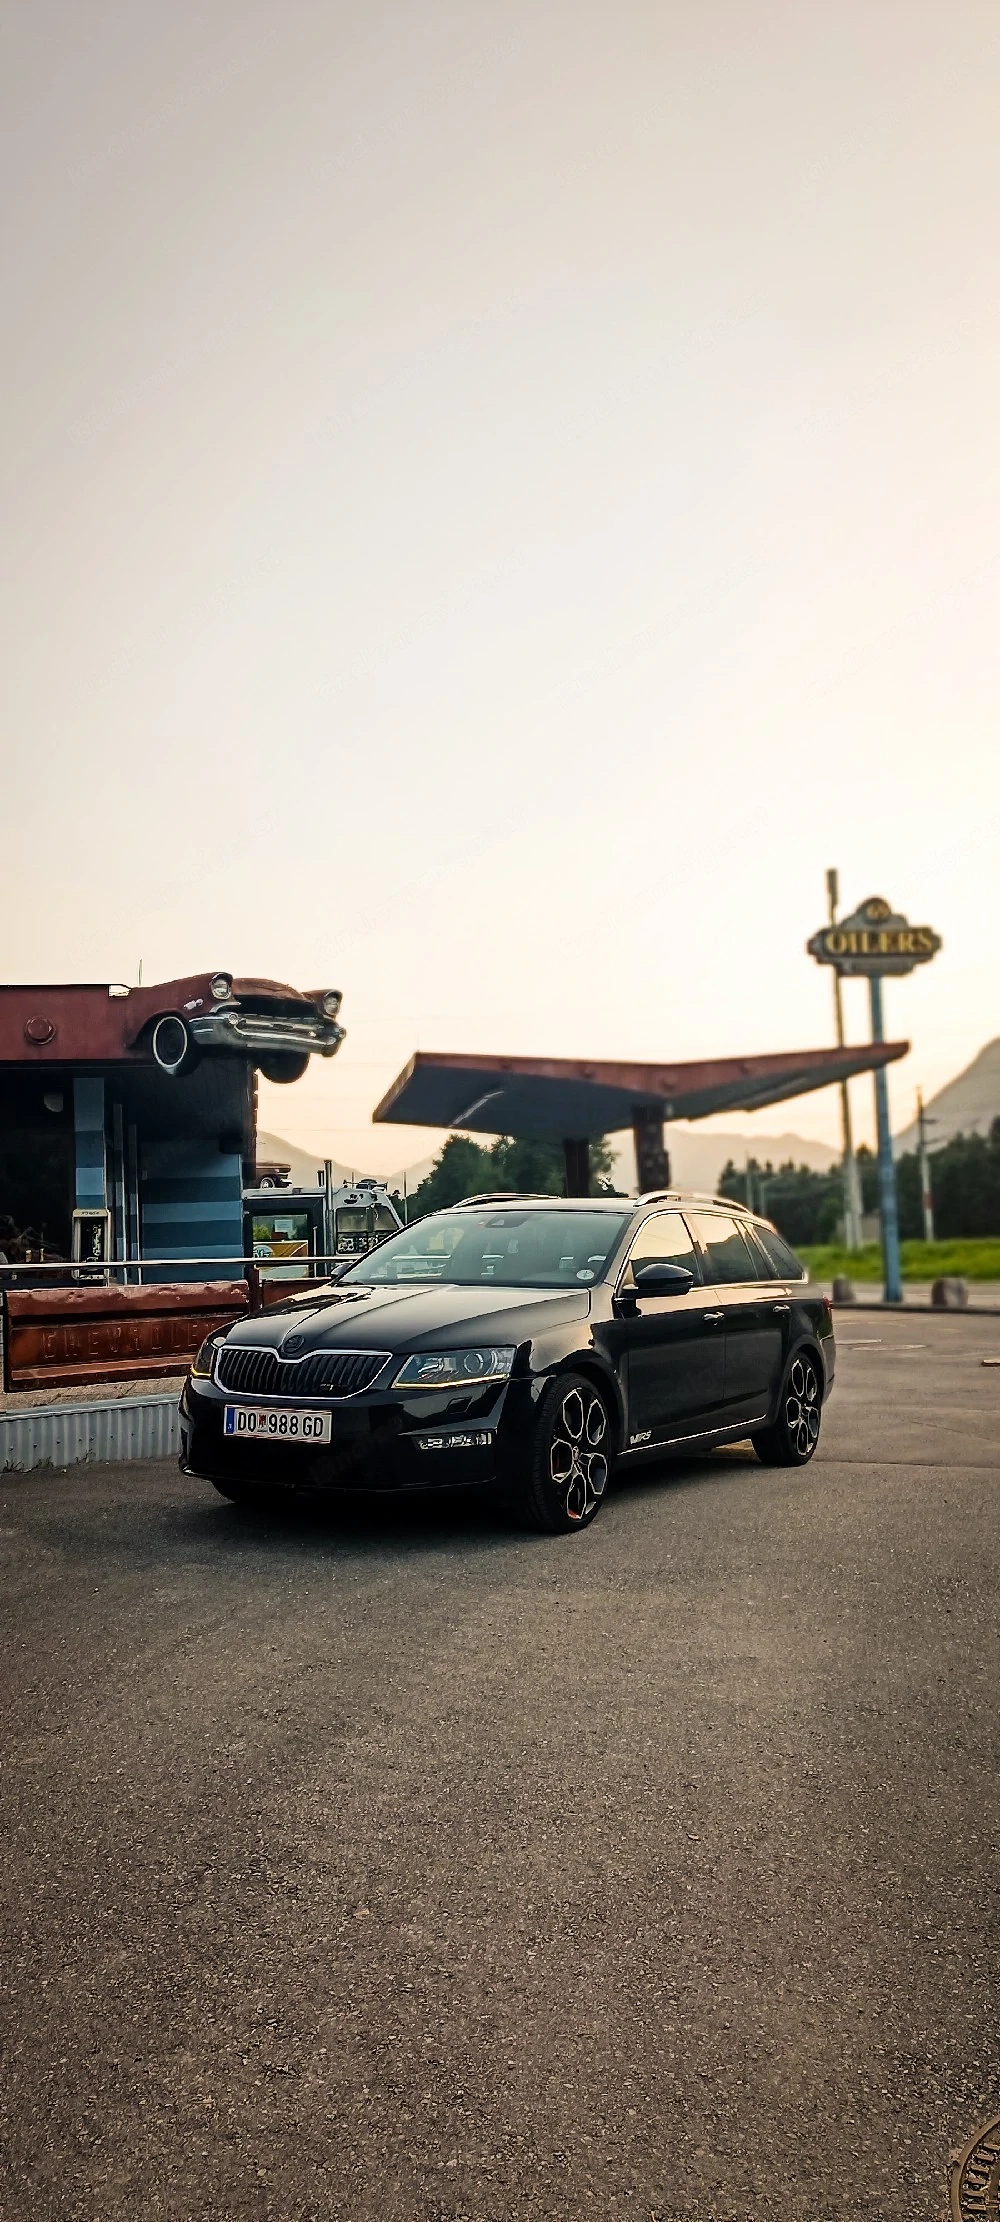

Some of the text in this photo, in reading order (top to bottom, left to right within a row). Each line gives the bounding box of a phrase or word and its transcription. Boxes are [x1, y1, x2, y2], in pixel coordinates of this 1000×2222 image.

[825, 931, 933, 955] OILERS
[238, 1412, 324, 1437] DO 988 GD
